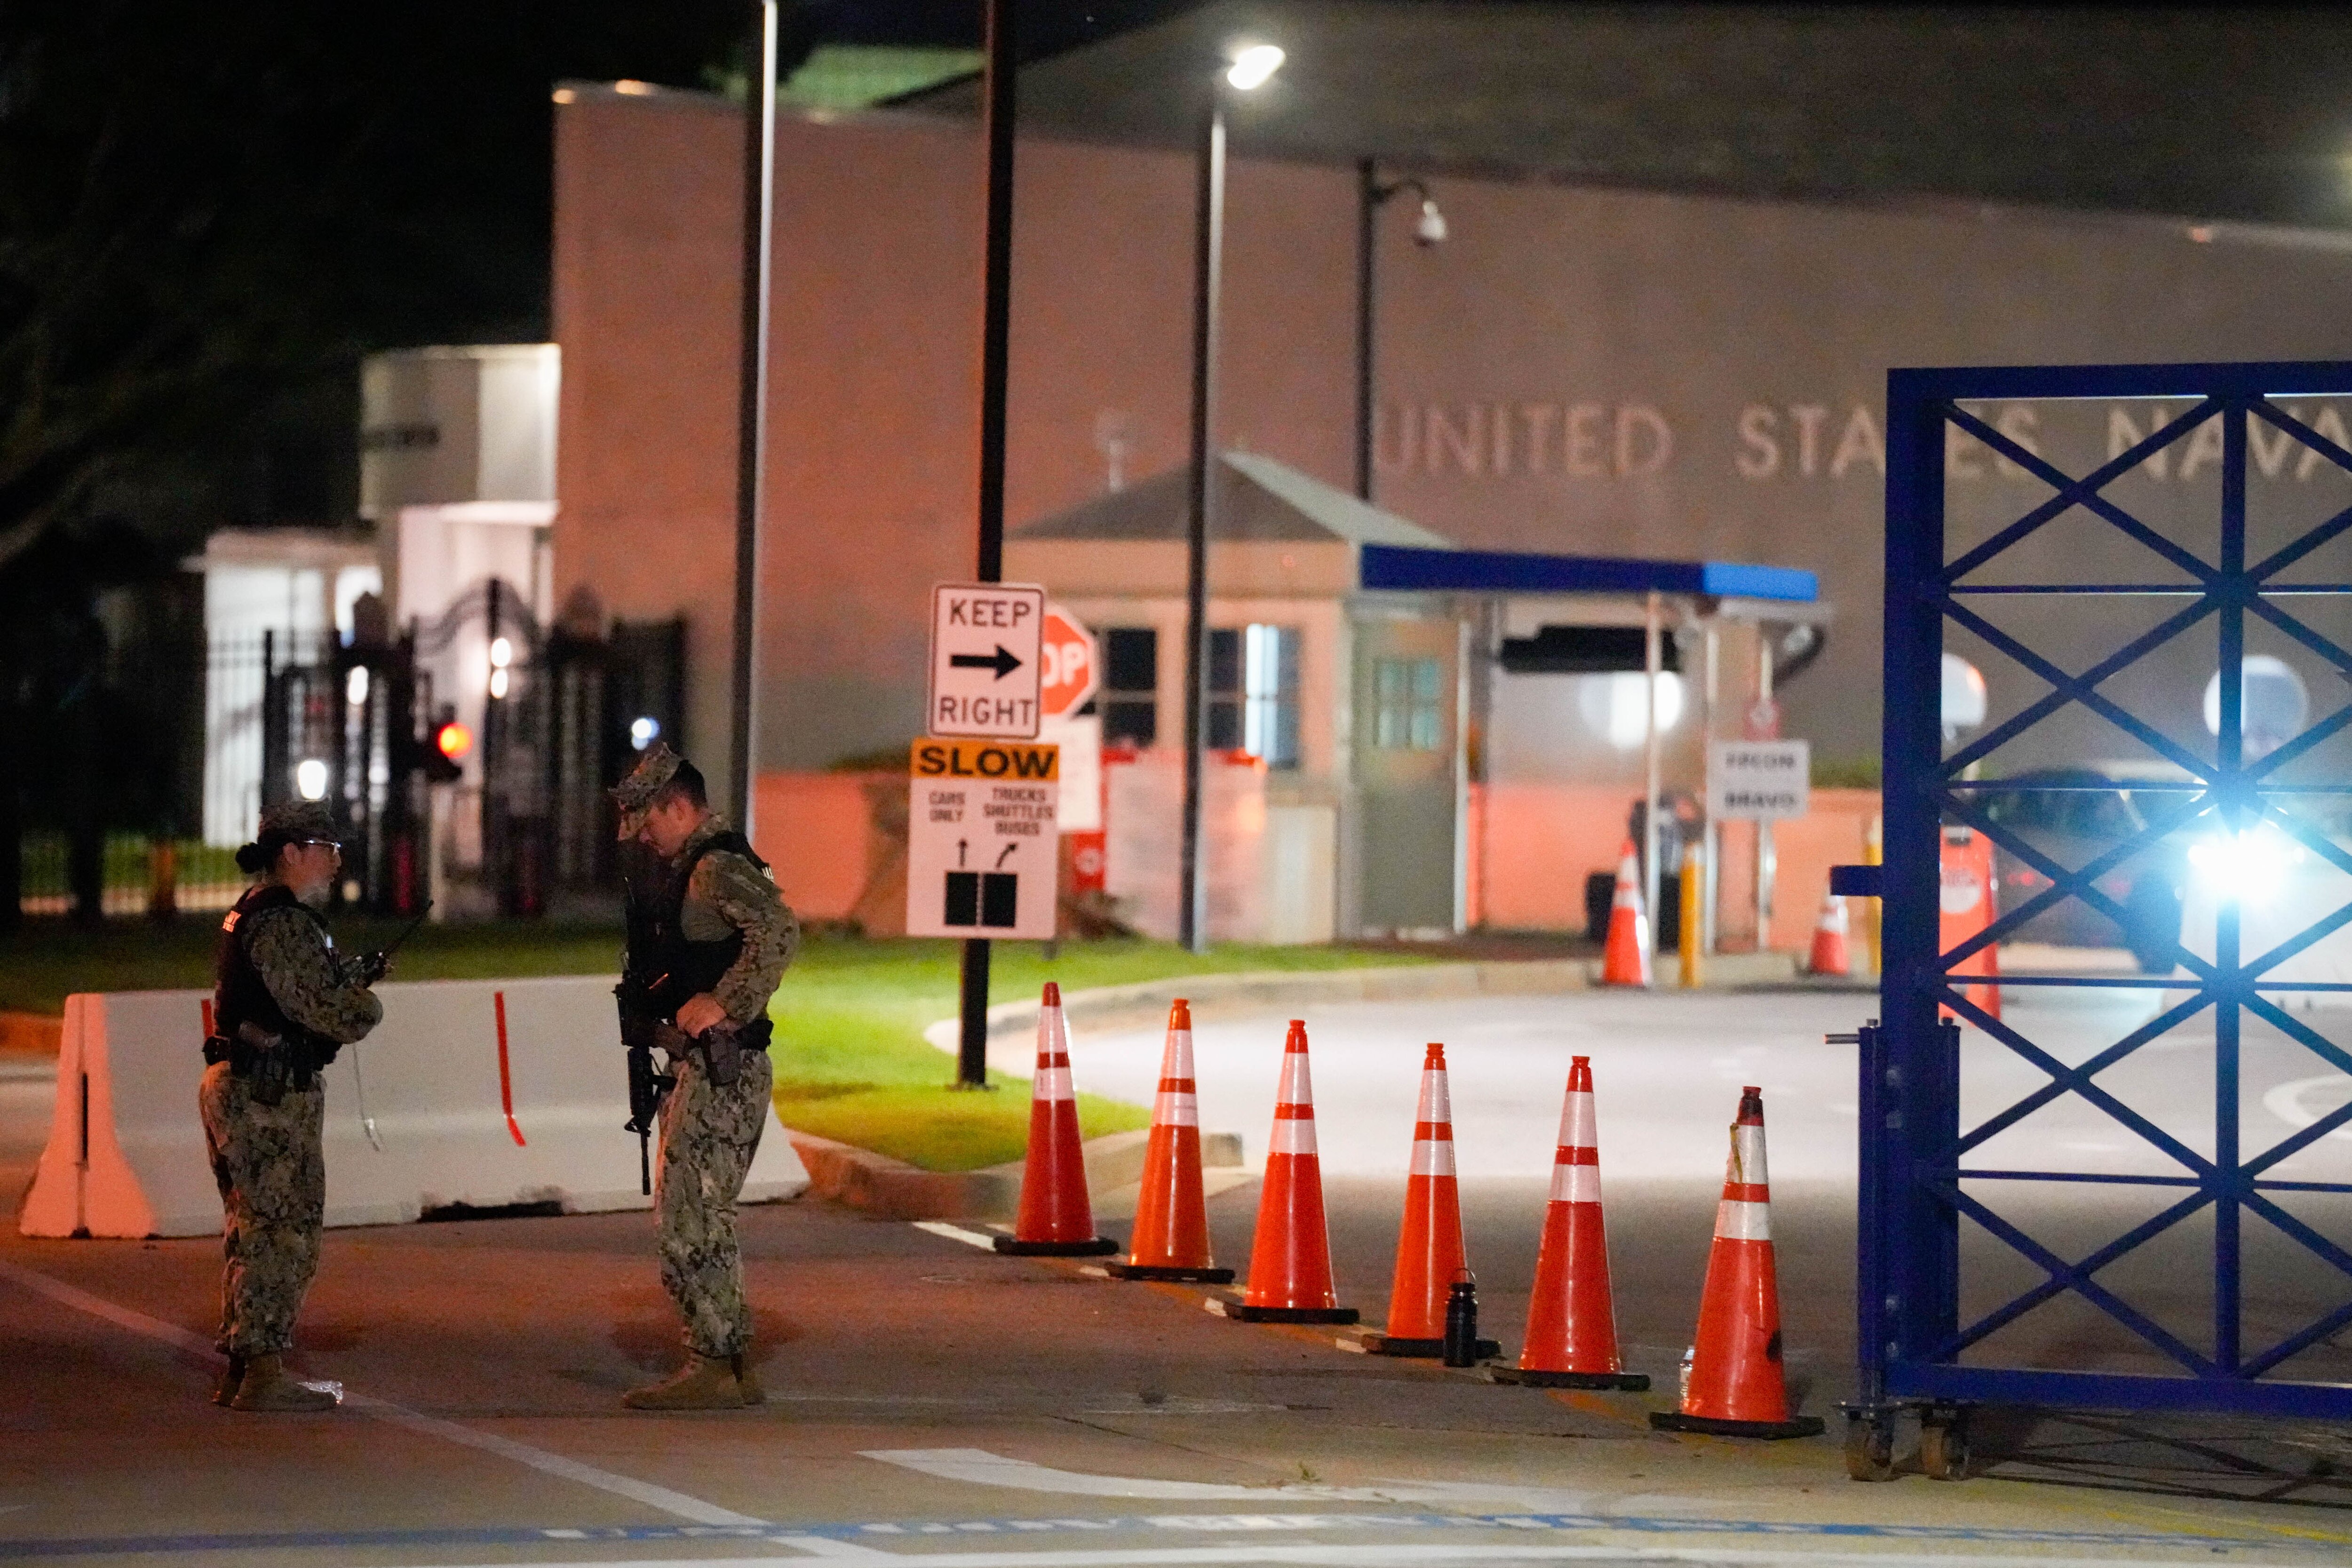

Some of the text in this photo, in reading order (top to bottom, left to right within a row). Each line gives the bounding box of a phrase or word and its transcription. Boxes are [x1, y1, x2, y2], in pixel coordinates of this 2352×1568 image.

[1375, 404, 1673, 476] UNITED
[1736, 404, 2040, 478] STAES
[949, 598, 1031, 628] KEEP
[1041, 642, 1086, 686] OP
[939, 696, 1034, 726] RIGHT
[920, 746, 1055, 778] SLOW
